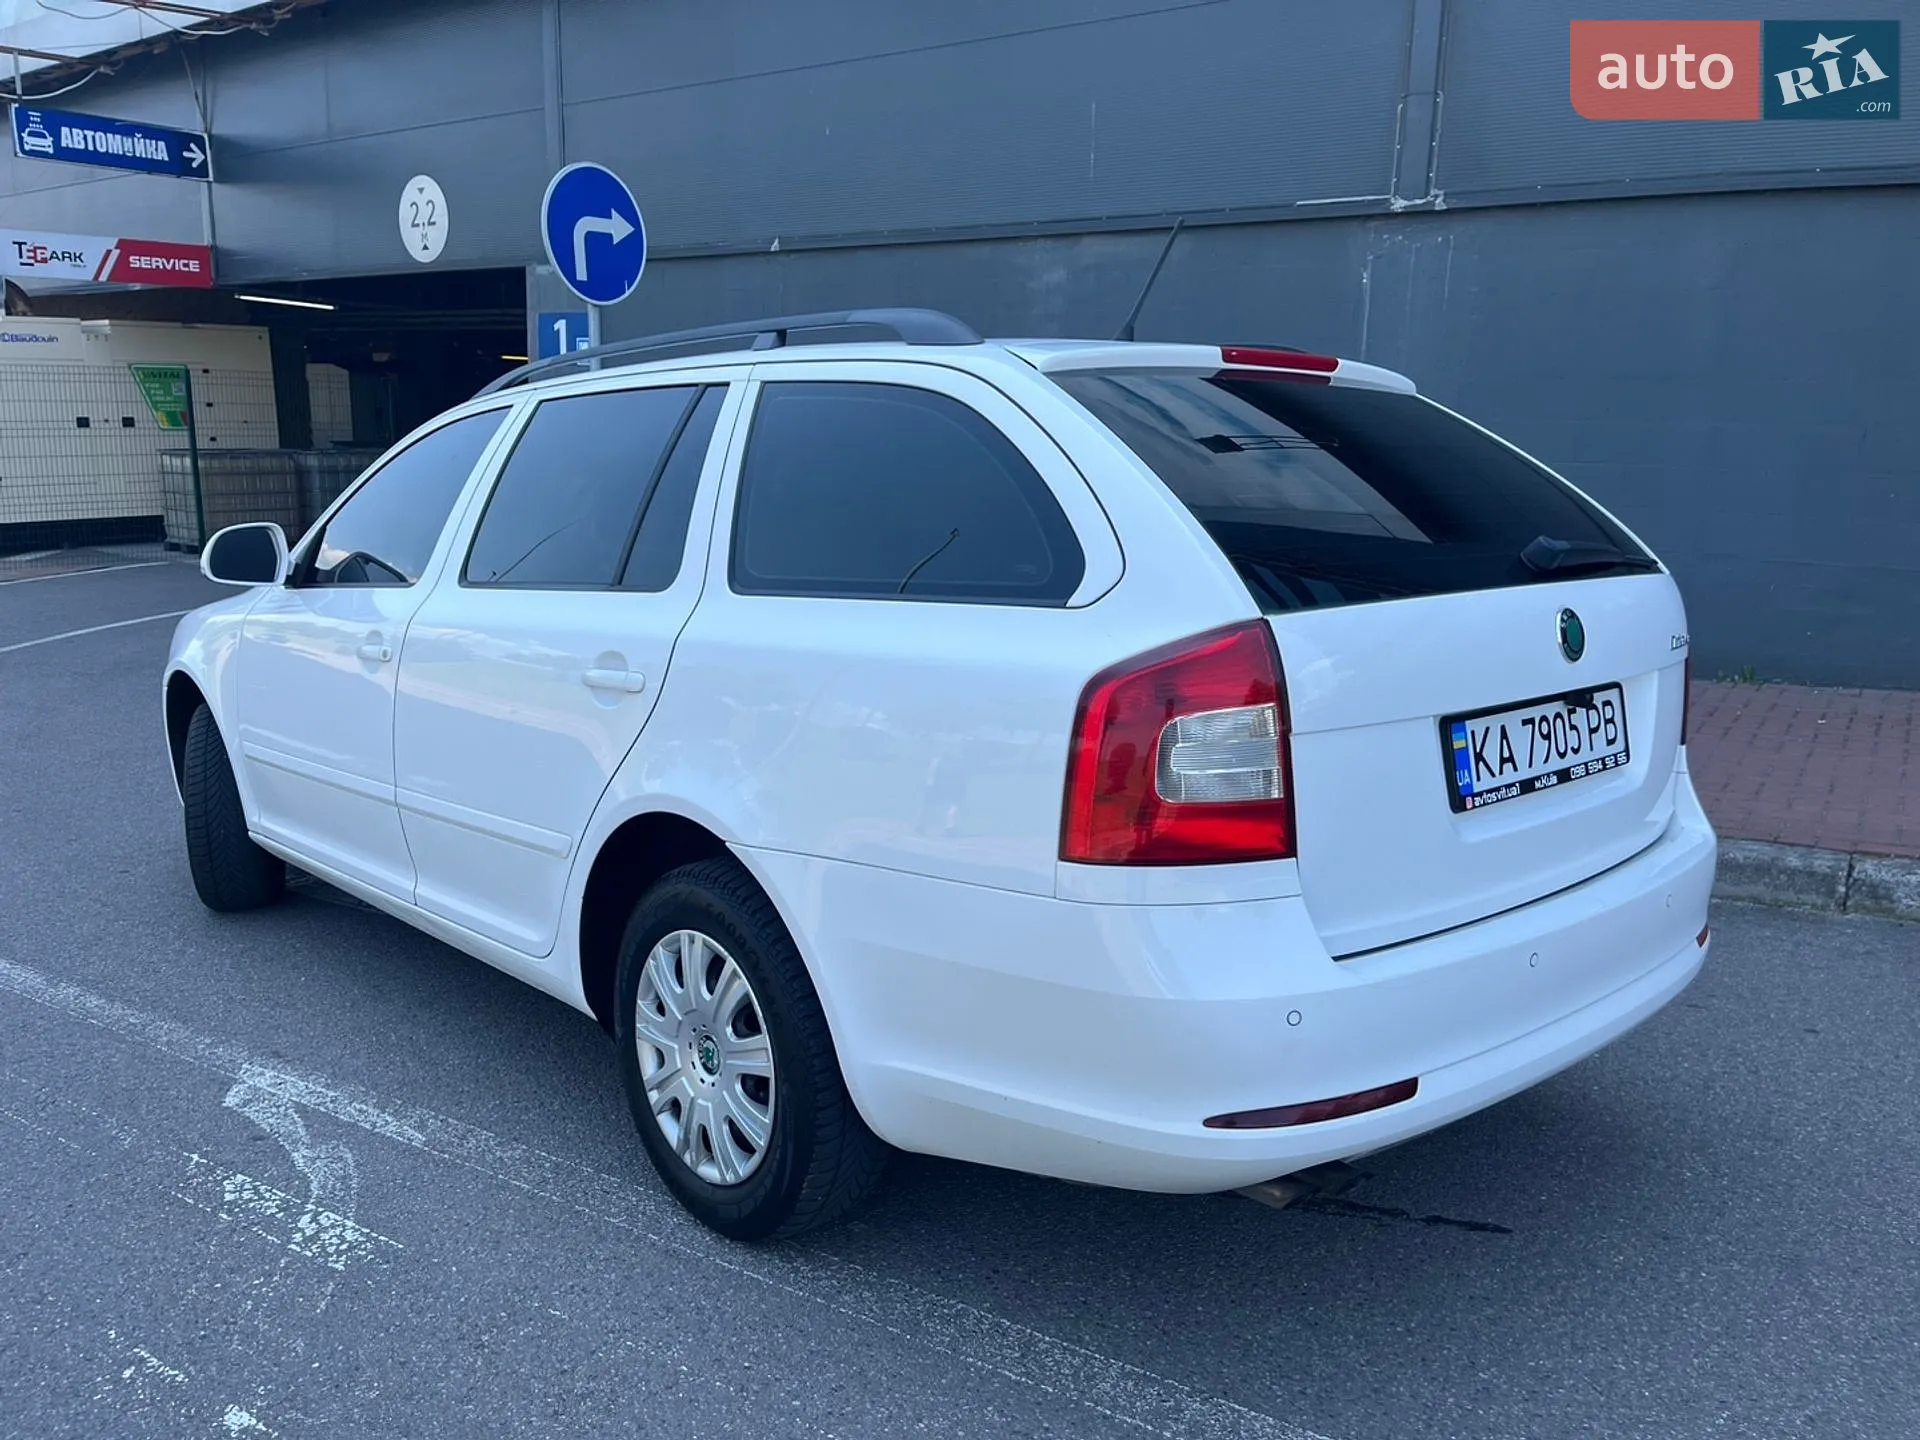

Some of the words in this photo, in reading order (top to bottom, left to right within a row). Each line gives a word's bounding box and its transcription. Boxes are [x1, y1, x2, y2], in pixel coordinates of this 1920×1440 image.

[409, 199, 437, 231] 2,2
[128, 255, 200, 272] SERVICE
[553, 318, 567, 355] 1
[1470, 723, 1519, 783] KA
[1521, 706, 1582, 769] 7905
[1586, 699, 1618, 752] PB
[1456, 769, 1471, 787] UA
